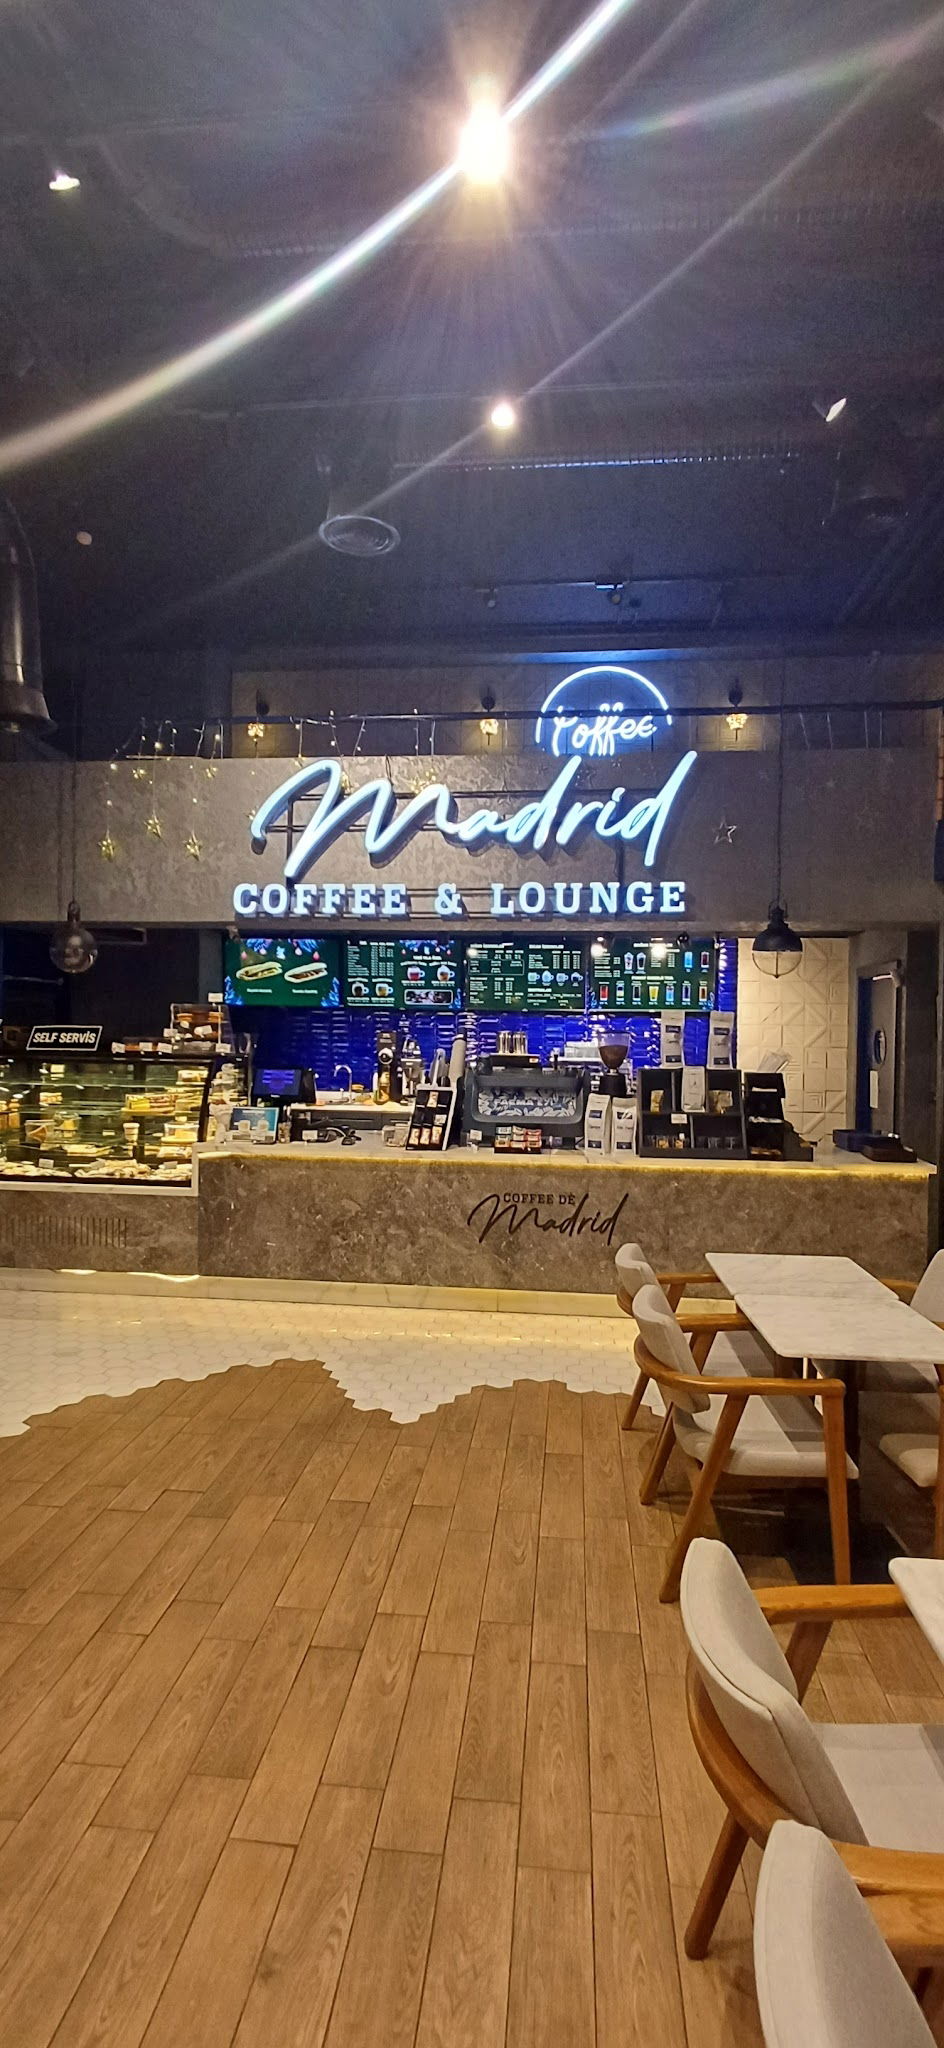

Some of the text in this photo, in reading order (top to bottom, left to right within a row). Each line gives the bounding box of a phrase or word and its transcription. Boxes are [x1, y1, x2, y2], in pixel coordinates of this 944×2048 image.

[250, 750, 698, 879] Madrid
[233, 881, 687, 915] COFFEE & LOUNGE
[33, 1031, 96, 1044] SELF SERVİS
[503, 1193, 554, 1205] COFFEE
[467, 1193, 629, 1246] Madrid
